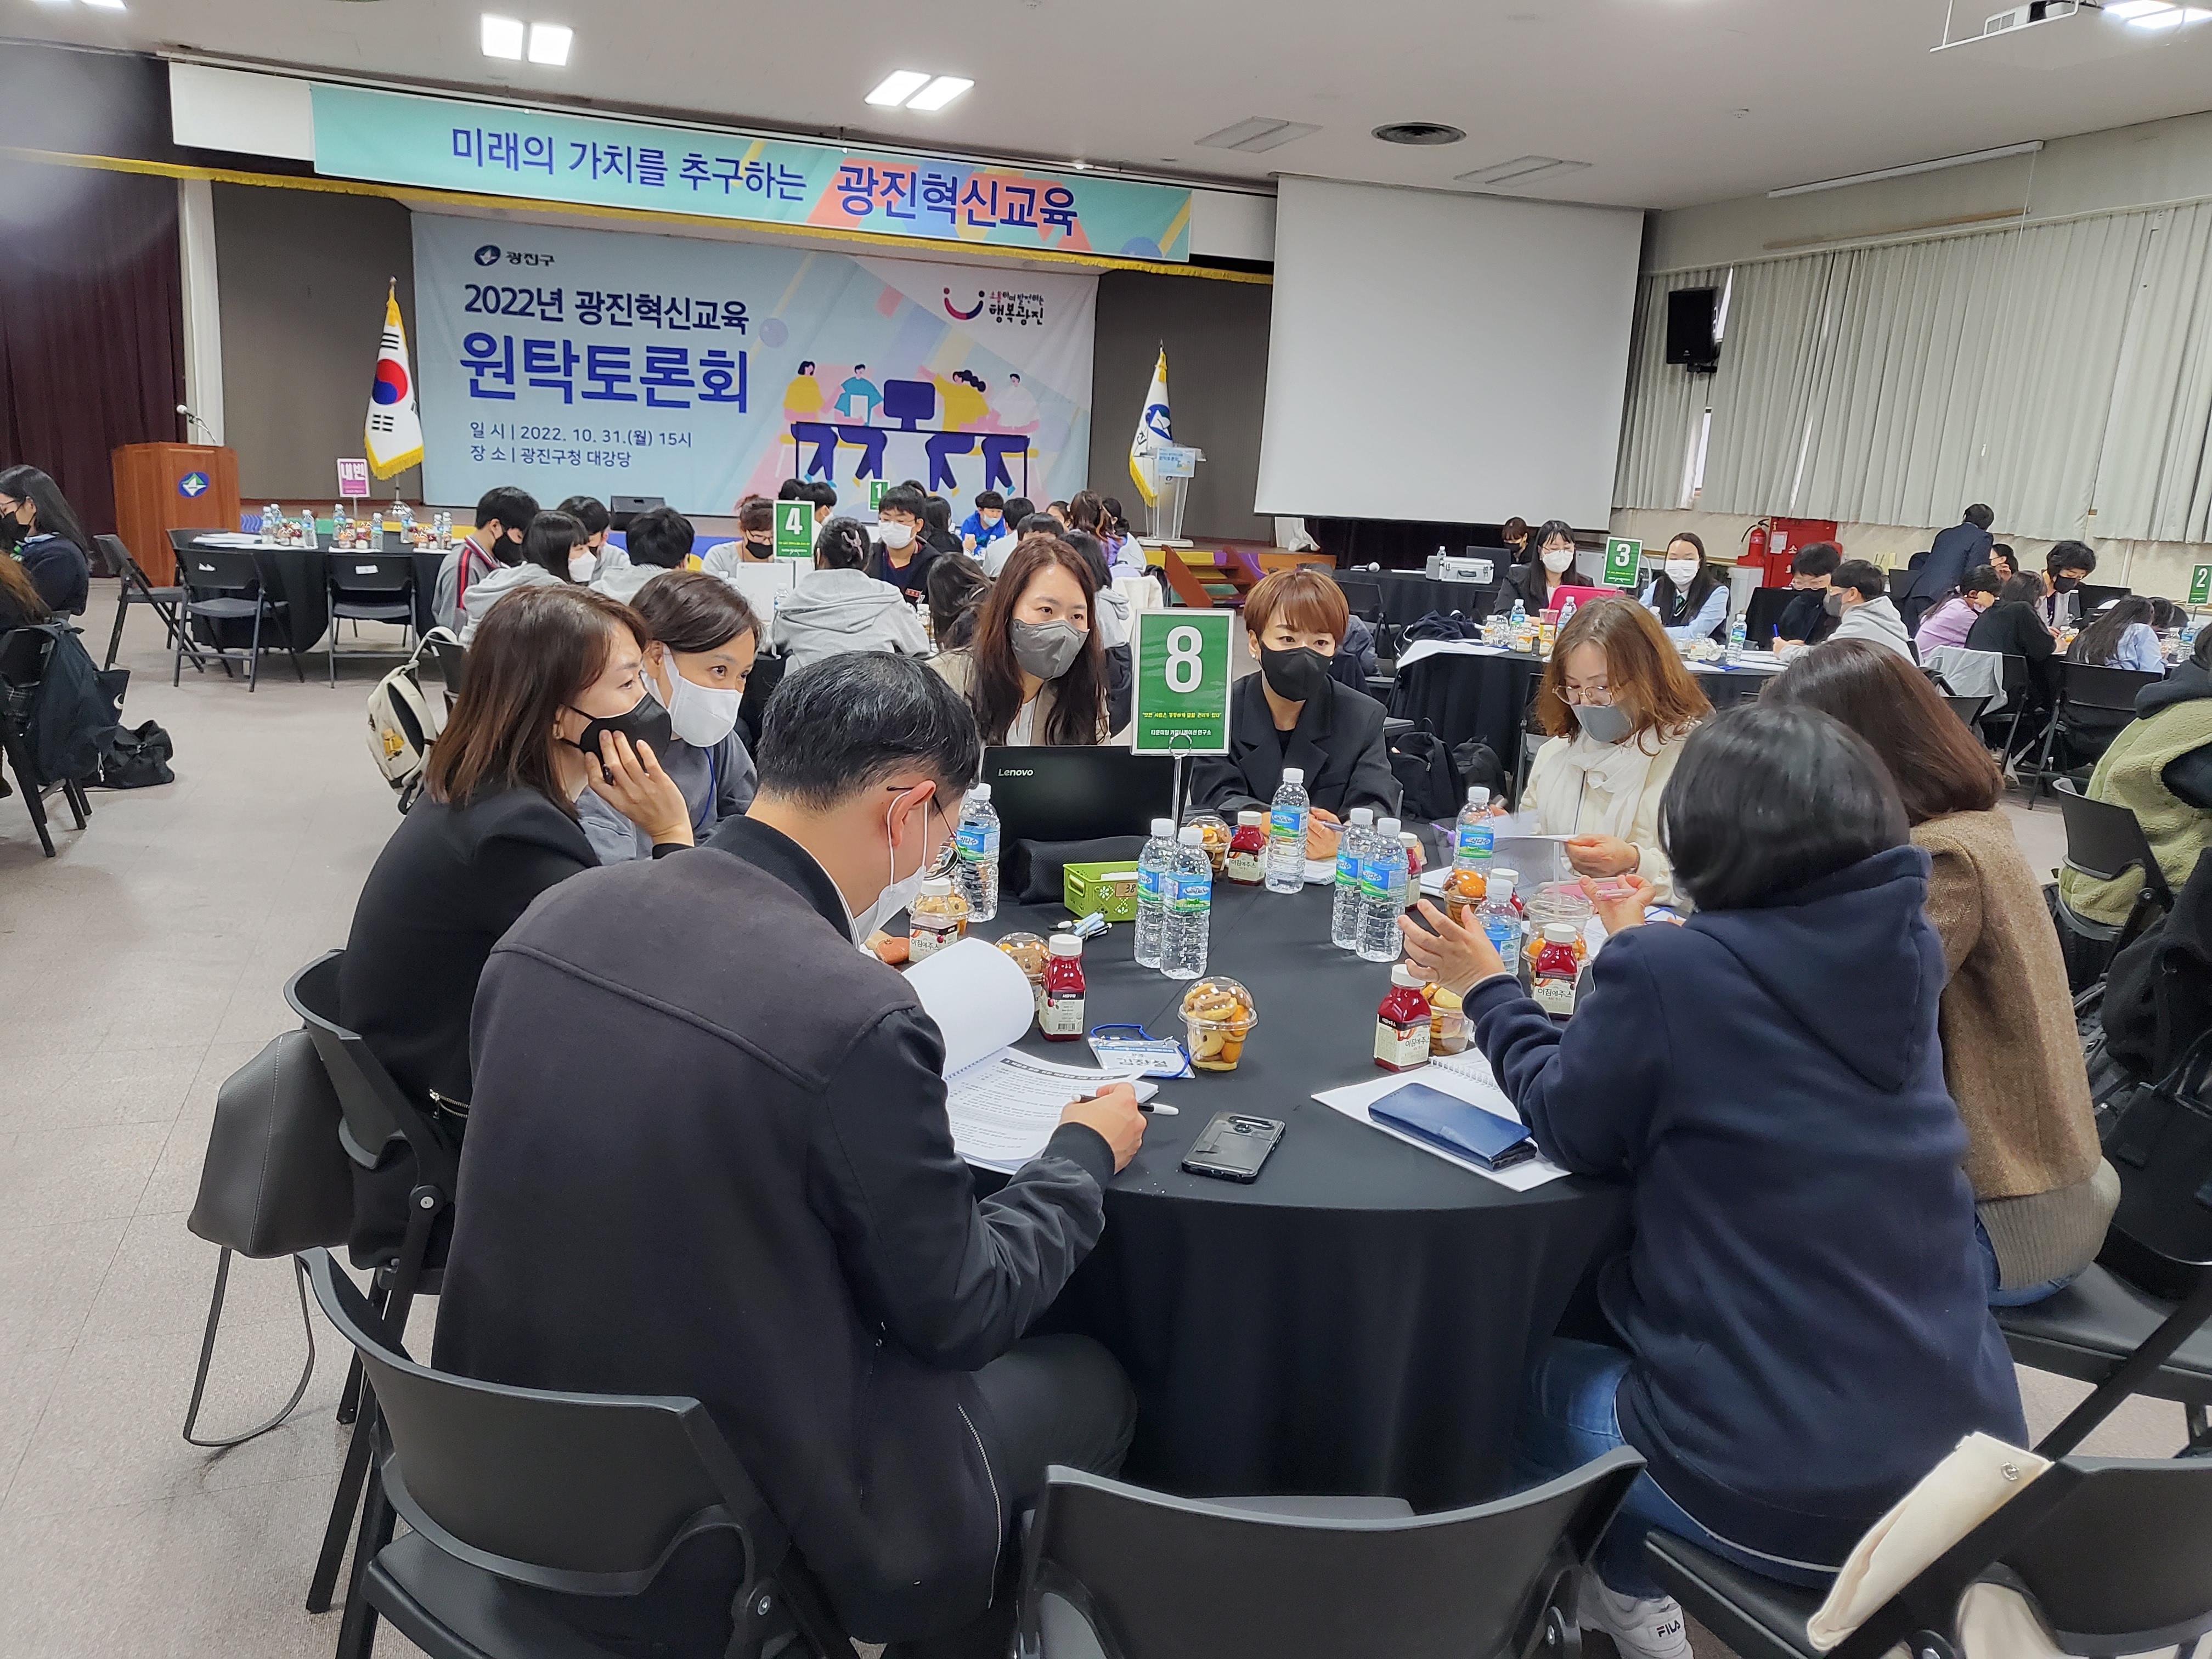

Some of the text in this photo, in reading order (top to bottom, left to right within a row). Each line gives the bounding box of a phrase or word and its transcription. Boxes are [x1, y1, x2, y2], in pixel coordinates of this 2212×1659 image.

[452, 128, 1077, 236] 미래의 가치를 추구하는 광진혁신교육
[506, 251, 555, 266] 광진구
[465, 284, 749, 335] 2022년 광진혁신교육
[989, 303, 1043, 325] 행복광진
[460, 332, 747, 414] 원탁토론회
[521, 426, 566, 441] 2022.
[573, 429, 596, 442] 10.
[659, 432, 692, 448] 15시
[521, 448, 581, 466] 광진구청
[587, 450, 631, 468] 대강당
[341, 463, 365, 481] 내빈
[876, 483, 882, 499] 1
[785, 507, 803, 535] 4
[1615, 543, 1631, 567] 3
[2196, 568, 2208, 588] 2
[1165, 625, 1203, 693] 8
[998, 768, 1034, 776] Lenovo
[960, 837, 977, 845] 삼다수
[1364, 871, 1380, 881] 삼다수
[1125, 883, 1136, 894] 38
[1656, 1620, 1681, 1638] FILA
